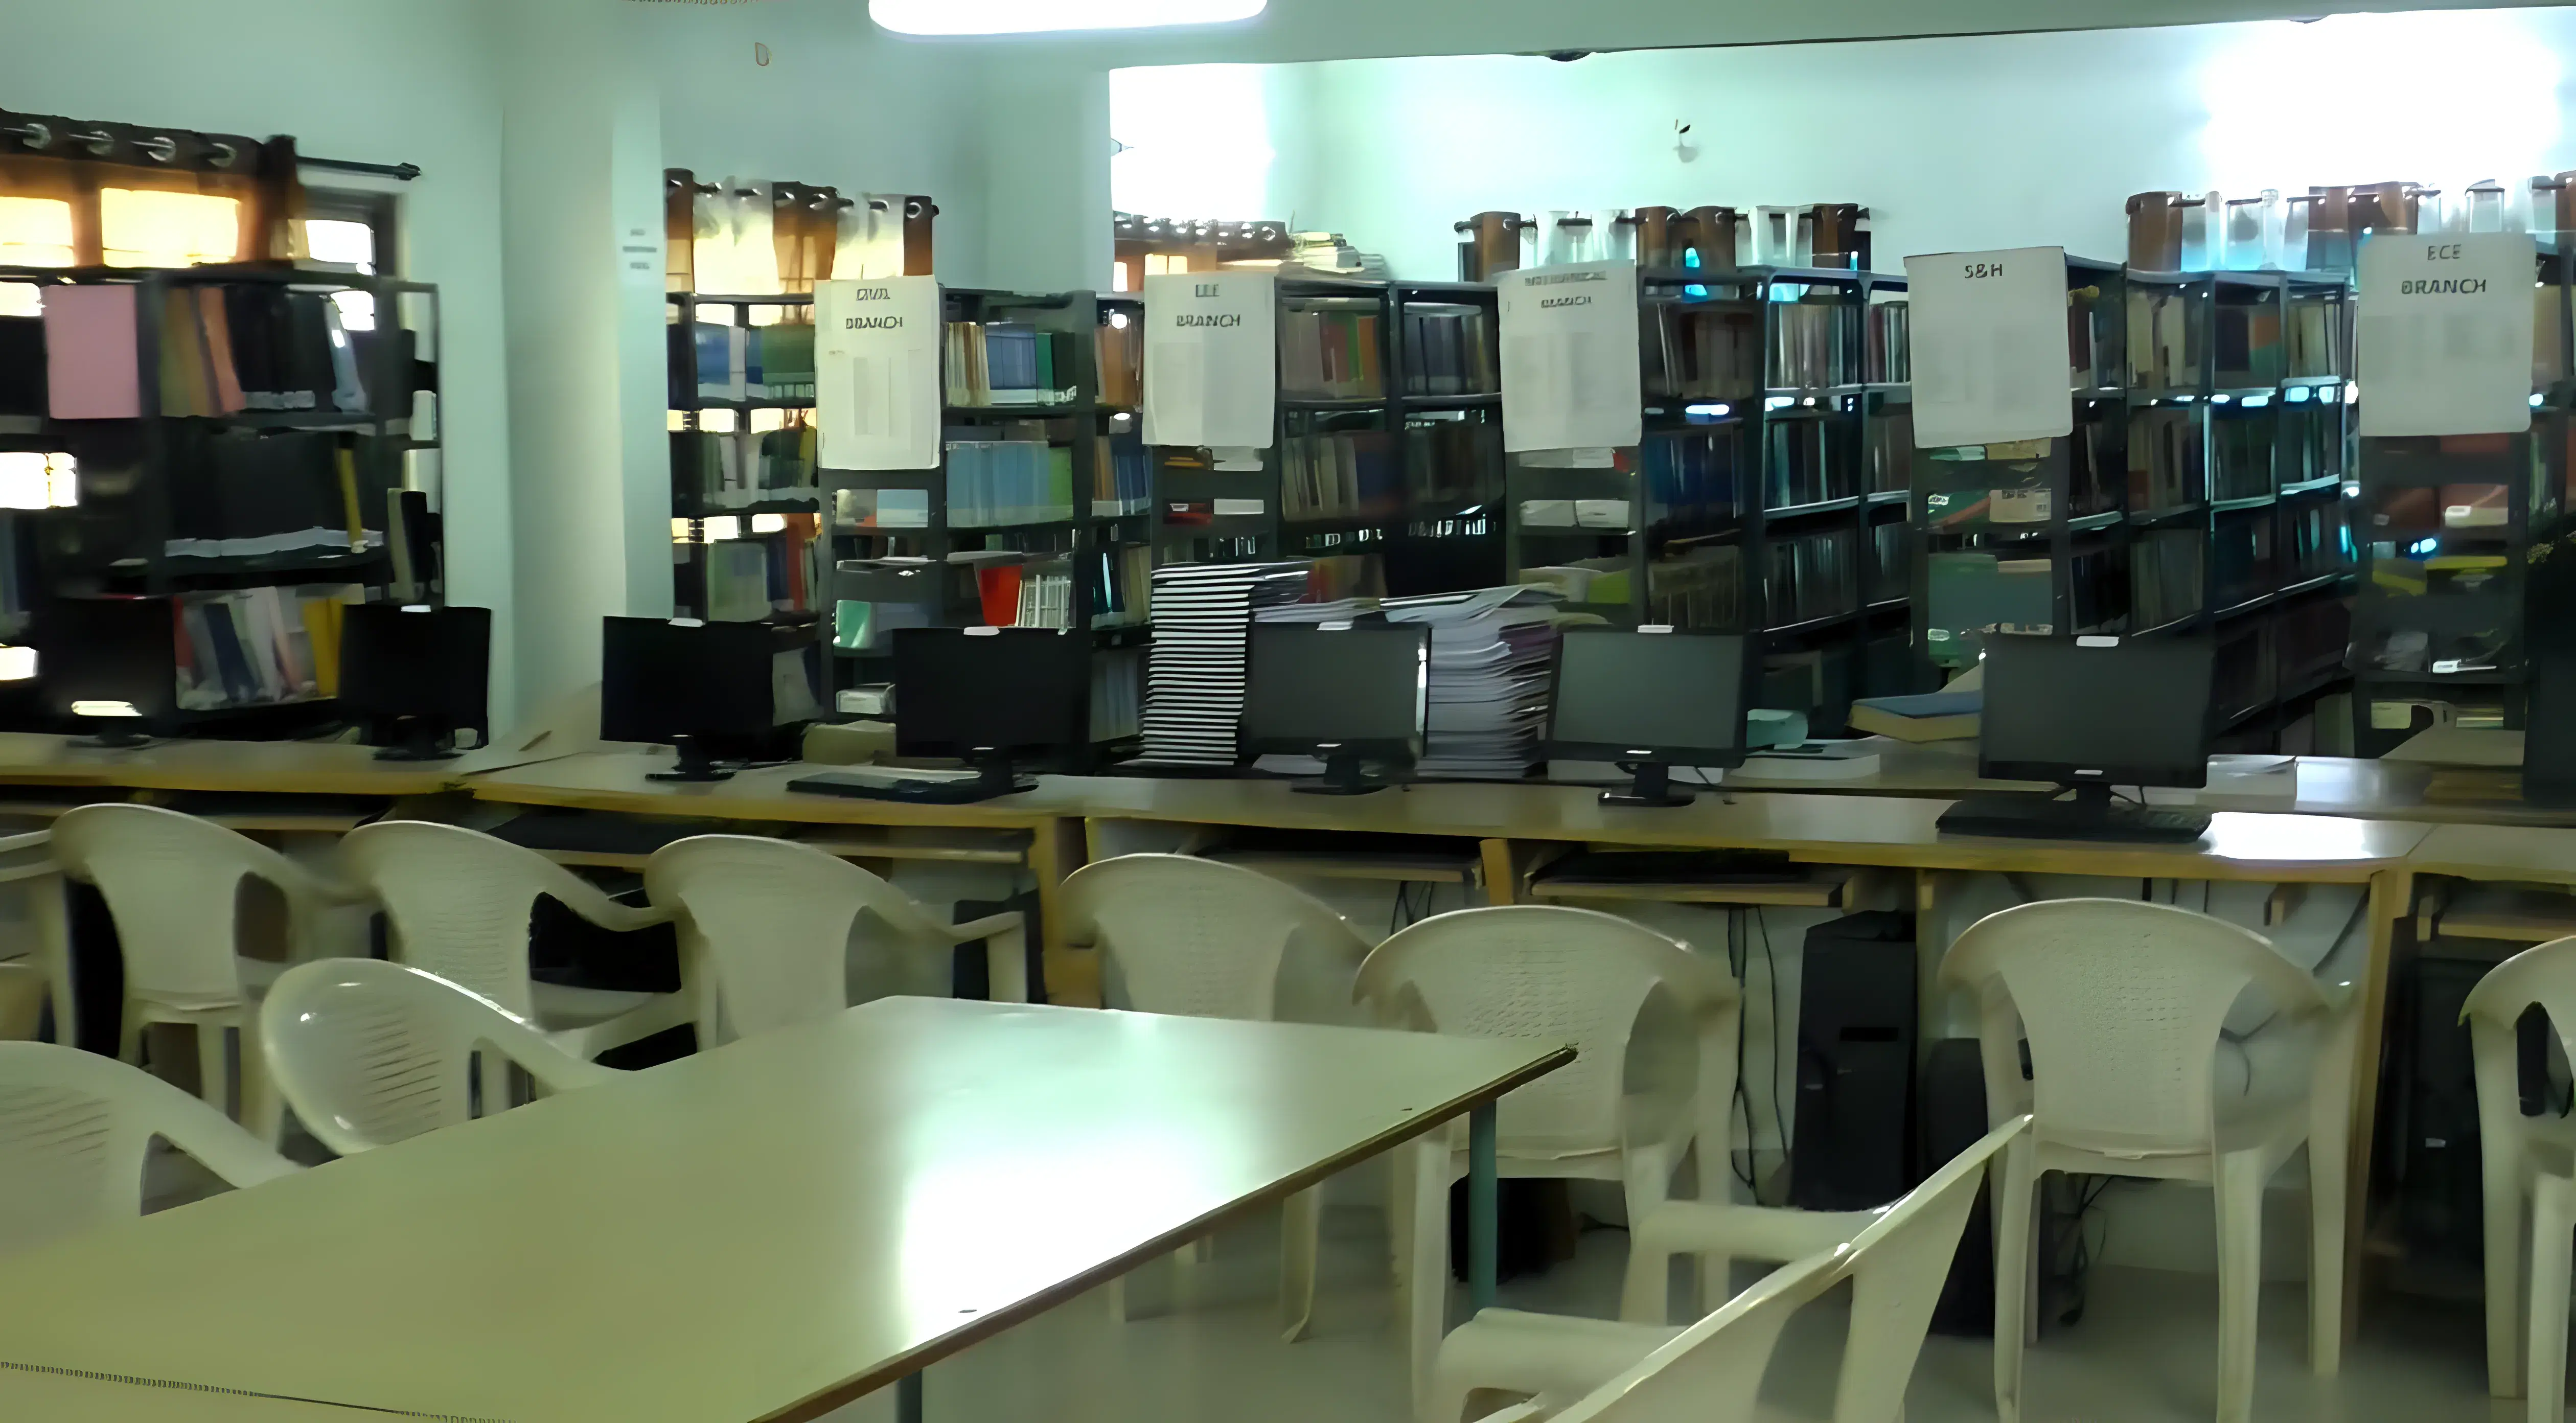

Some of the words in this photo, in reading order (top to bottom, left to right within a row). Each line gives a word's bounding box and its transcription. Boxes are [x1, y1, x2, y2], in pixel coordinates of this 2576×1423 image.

[2427, 244, 2462, 261] ECE
[1965, 263, 2003, 279] S&H
[2401, 279, 2487, 294] BRANCH
